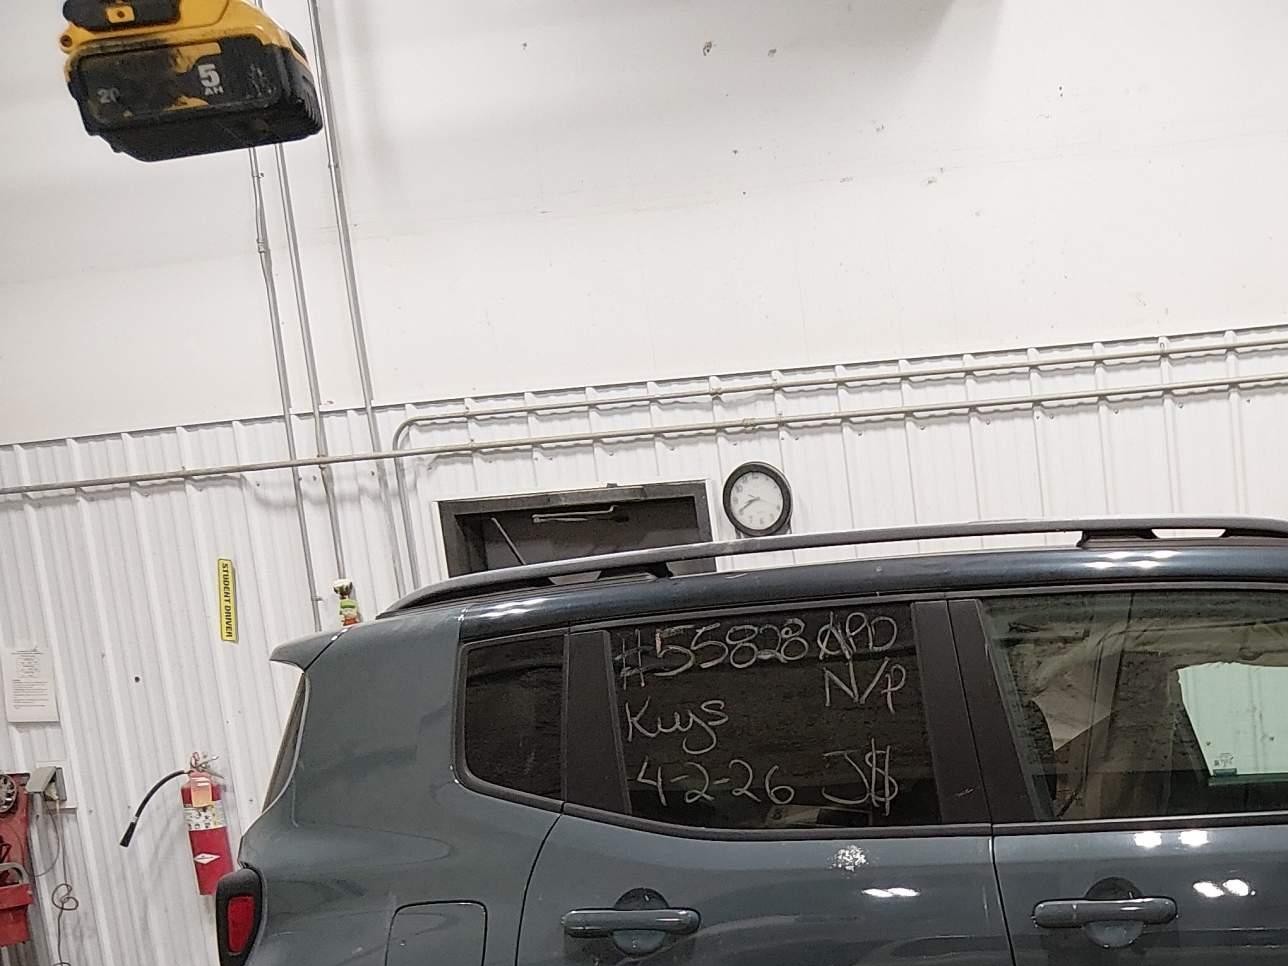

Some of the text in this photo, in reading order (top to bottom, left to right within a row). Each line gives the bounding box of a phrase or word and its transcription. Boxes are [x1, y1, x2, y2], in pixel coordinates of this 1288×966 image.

[198, 64, 221, 88] 5
[222, 562, 233, 638] STUDENT DRIVER
[614, 618, 809, 690] #55828
[637, 756, 795, 806] 4-2-26
